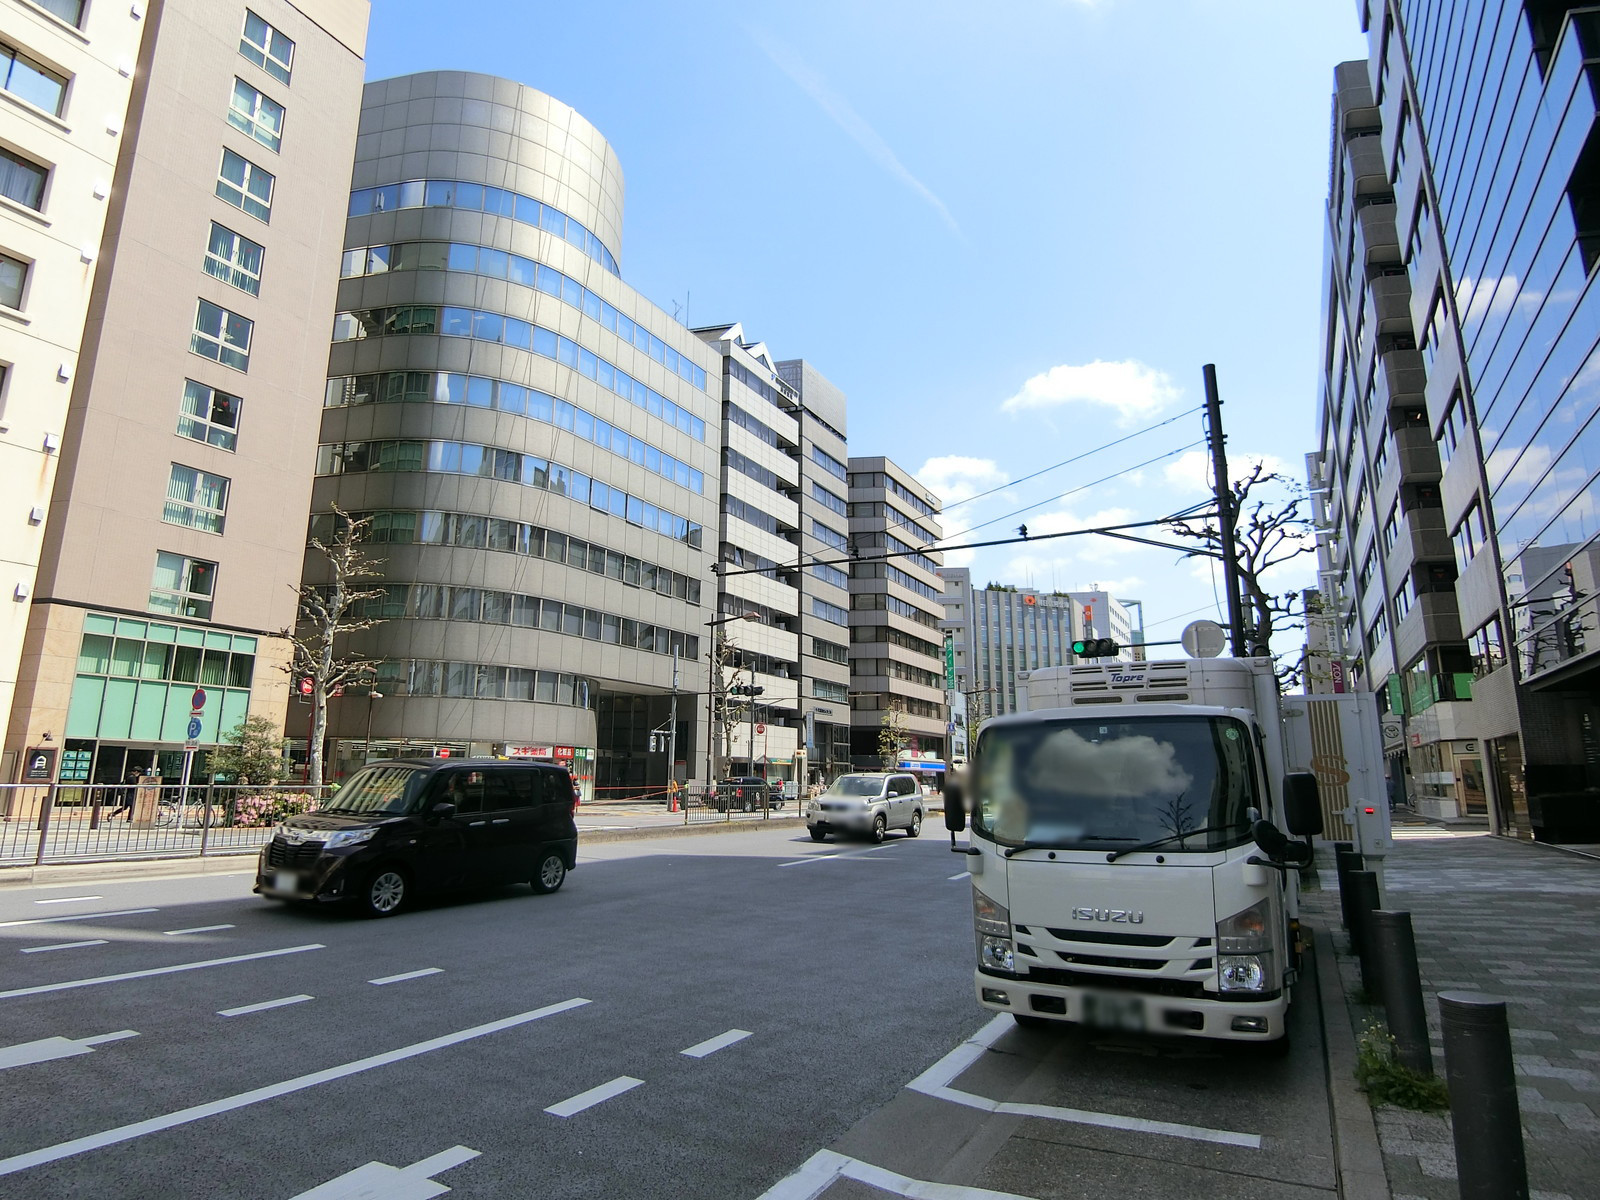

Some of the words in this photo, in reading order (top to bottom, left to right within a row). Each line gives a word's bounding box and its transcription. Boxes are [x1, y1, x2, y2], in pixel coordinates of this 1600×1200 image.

[1111, 673, 1144, 683] Topre
[513, 746, 547, 756] スギ薬局
[1072, 907, 1144, 924] ISUZU
